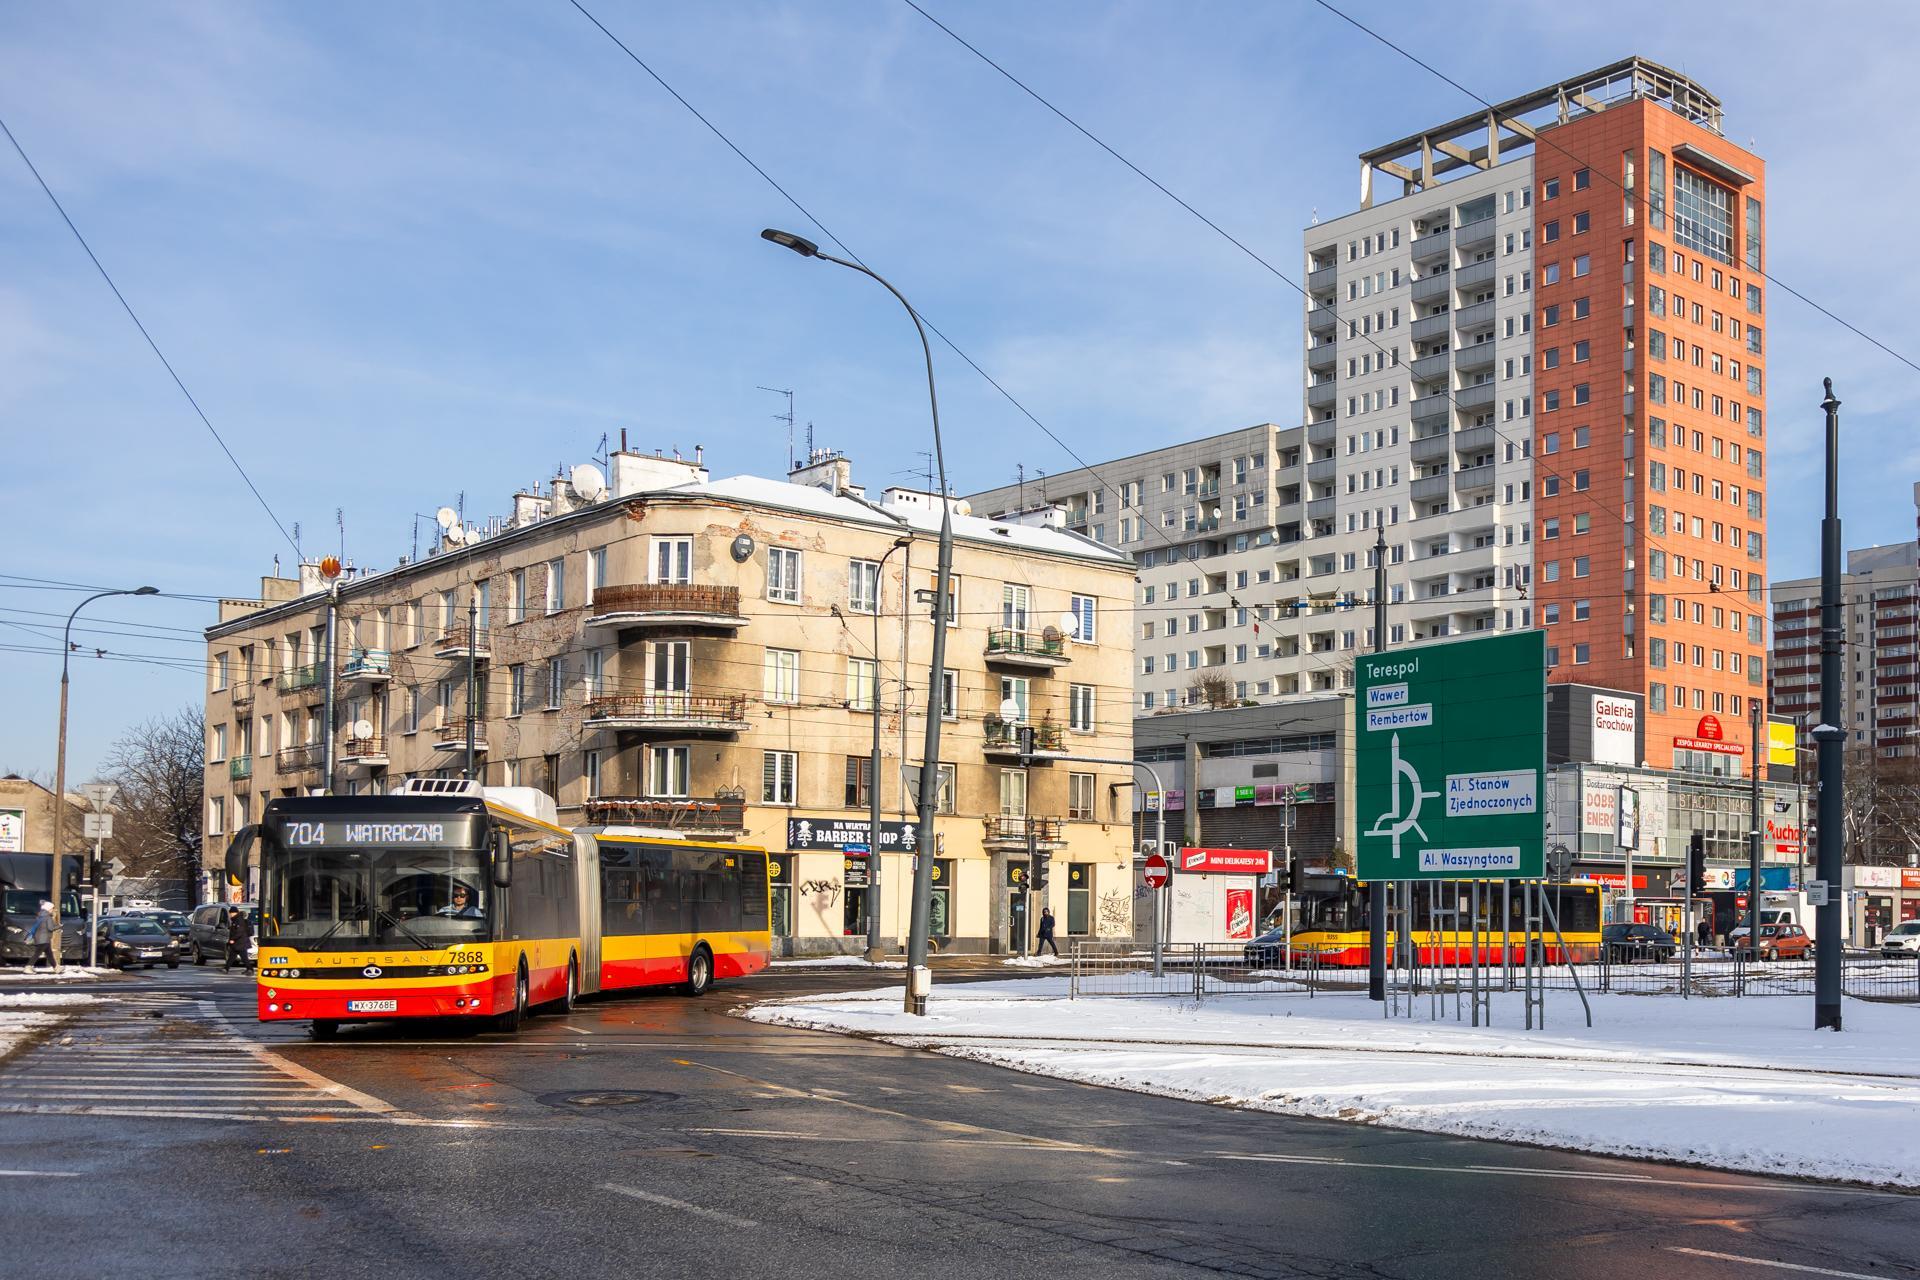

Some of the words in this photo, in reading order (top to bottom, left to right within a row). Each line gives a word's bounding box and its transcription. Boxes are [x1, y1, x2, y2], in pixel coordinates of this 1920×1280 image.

[1366, 657, 1419, 679] Terespol
[1370, 690, 1405, 702] Wawer
[1596, 700, 1634, 718] Galeria
[1370, 709, 1428, 726] Rembertów
[1596, 717, 1633, 732] Grochów
[1694, 741, 1713, 749] LEKARZY
[1450, 780, 1464, 792] Al.
[1468, 776, 1510, 791] Stanów
[1450, 794, 1532, 813] Zjednoczonych
[1586, 792, 1615, 809] DOBR
[833, 821, 844, 830] NA
[286, 822, 325, 845] 704
[346, 824, 444, 842] WIATRACZNA
[816, 830, 864, 843] BARBER
[1224, 857, 1254, 865] DELIKATESY
[1424, 853, 1437, 866] Al.
[1441, 852, 1513, 868] Waszyngtona
[315, 955, 429, 965] AUTOSAN
[449, 951, 483, 963] 7868
[368, 1000, 395, 1009] 3768E
